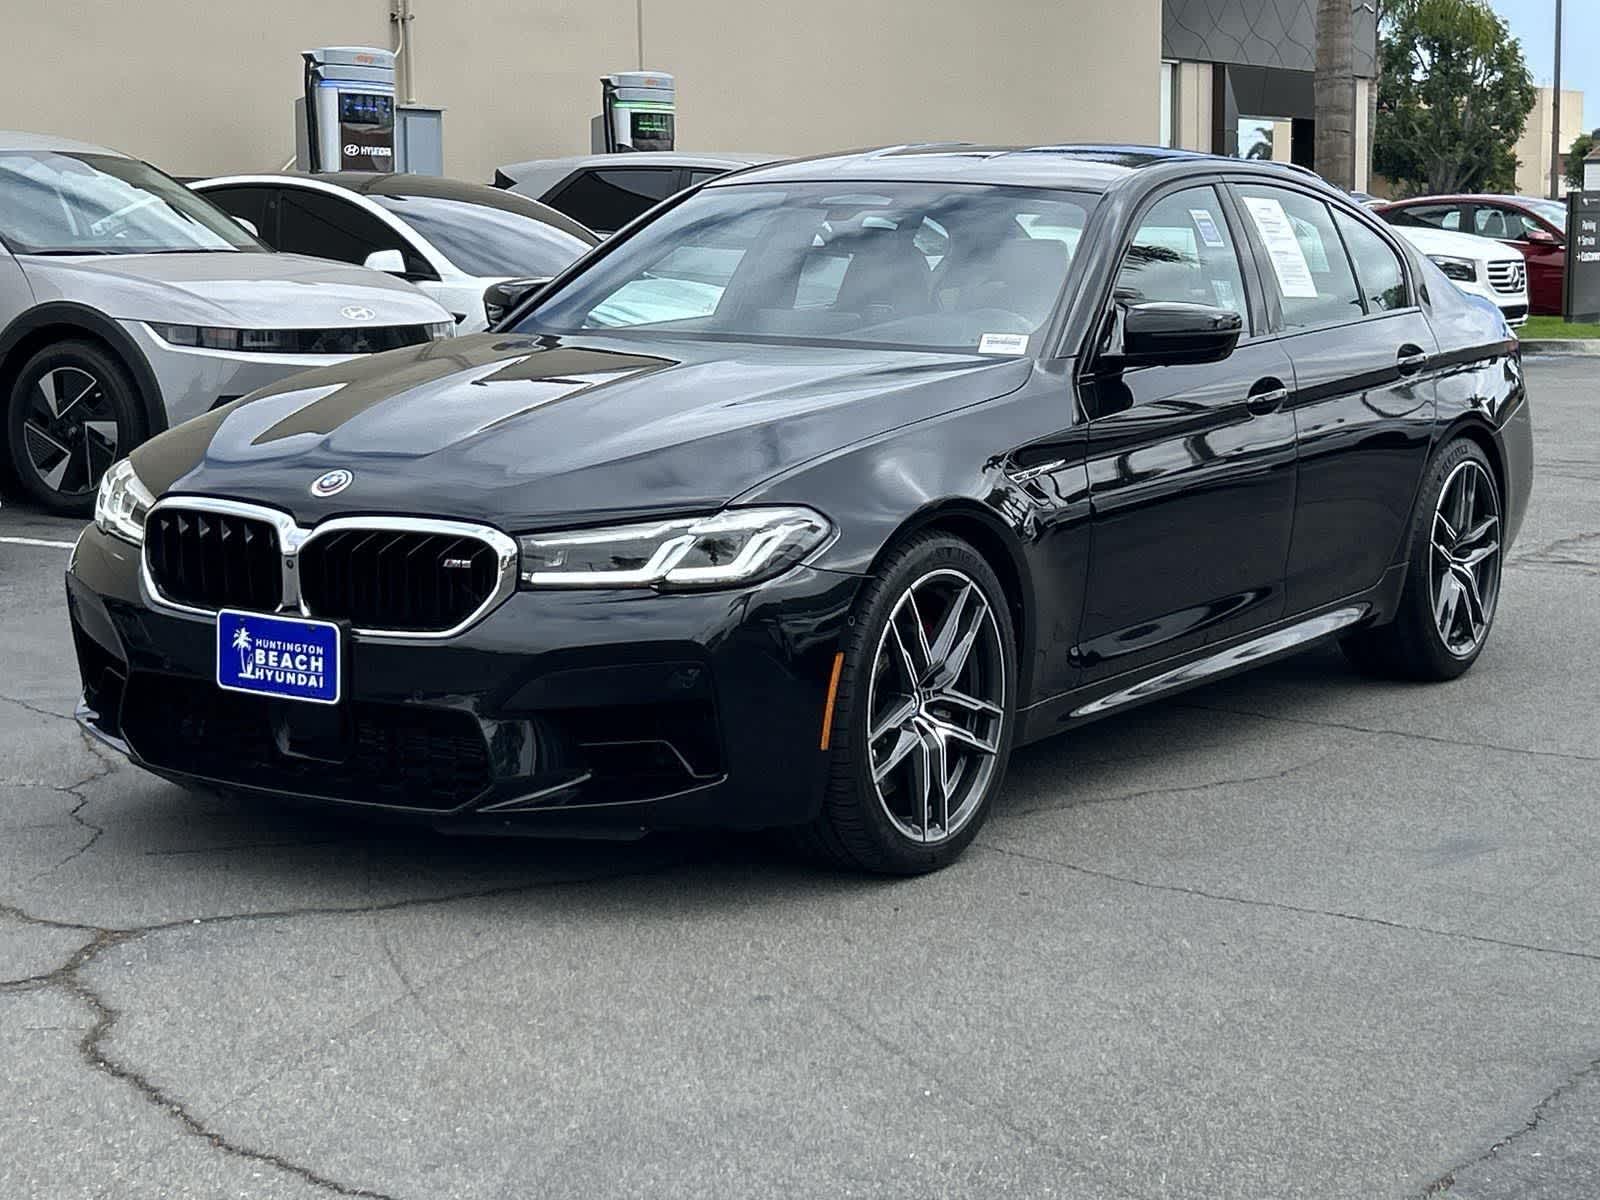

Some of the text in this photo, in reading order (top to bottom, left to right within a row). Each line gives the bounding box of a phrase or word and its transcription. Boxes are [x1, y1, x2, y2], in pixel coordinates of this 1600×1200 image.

[255, 638, 324, 655] HUNTINGTON
[255, 648, 323, 673] BEACH
[255, 667, 324, 689] HYUNDAI
